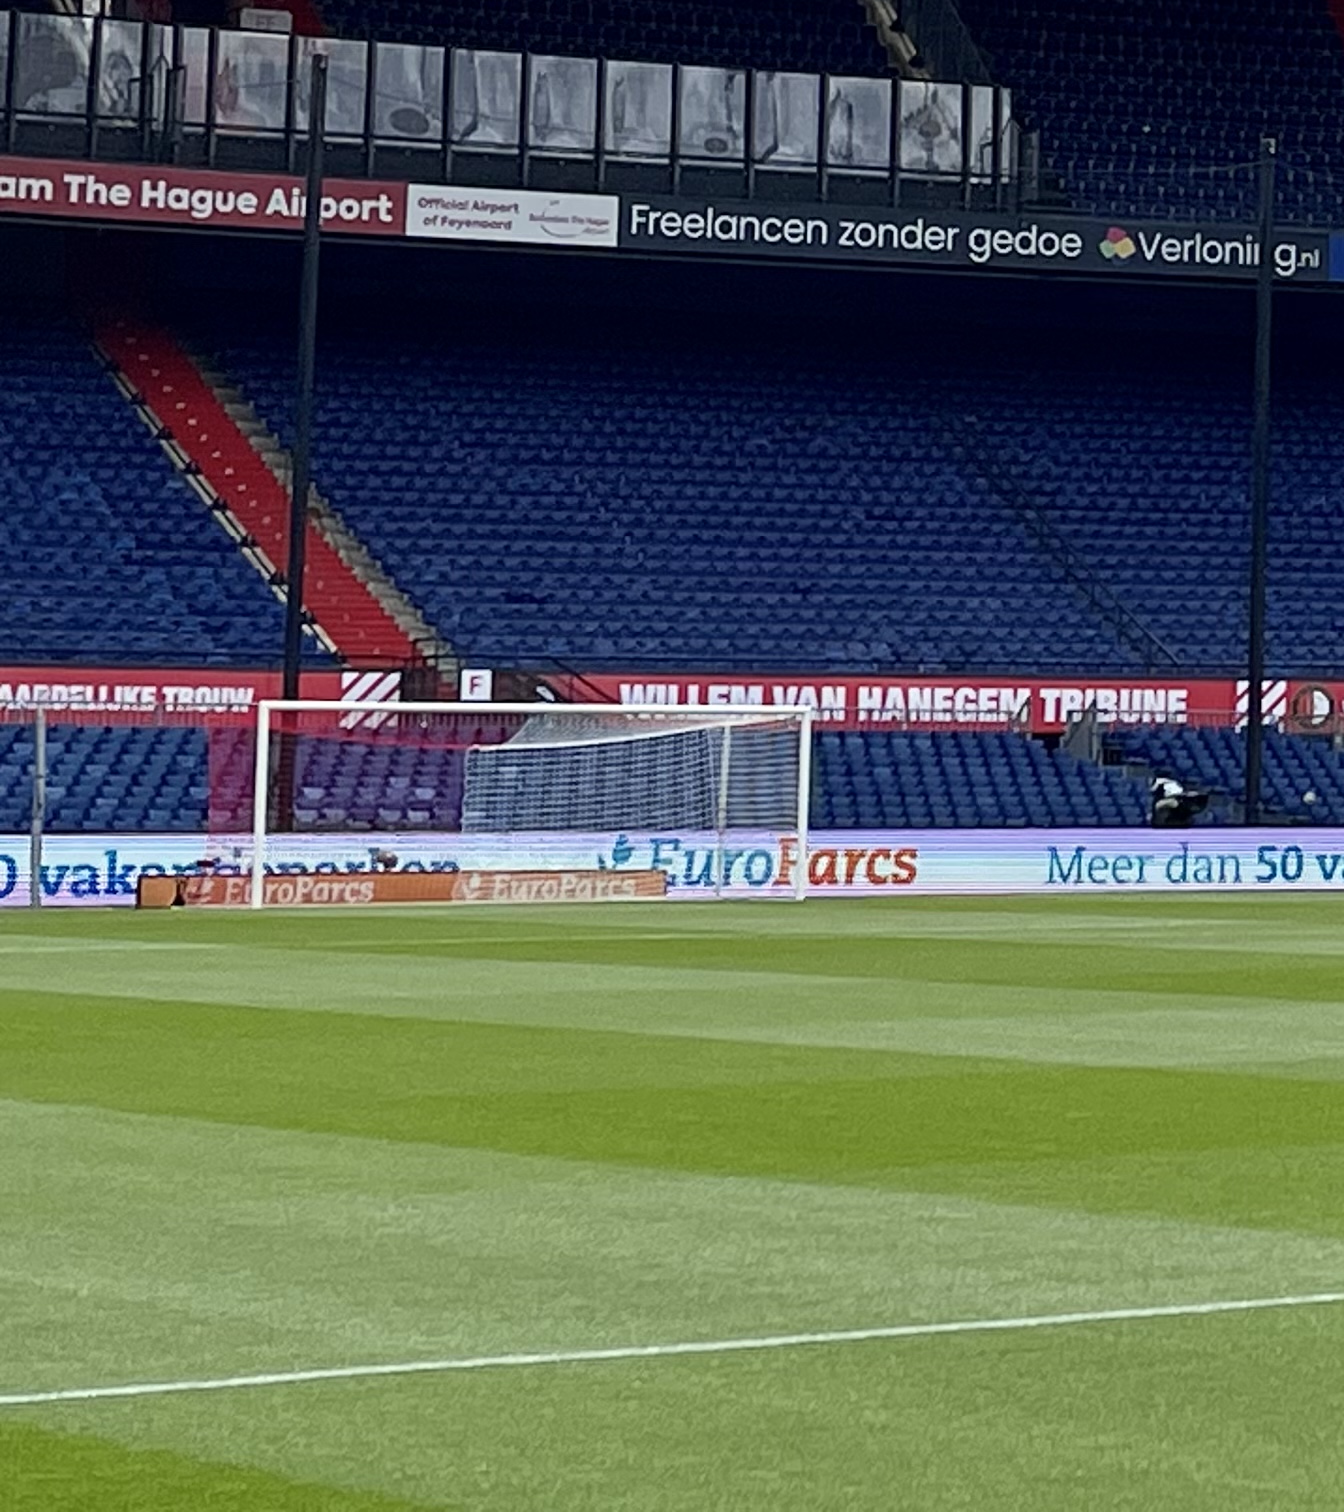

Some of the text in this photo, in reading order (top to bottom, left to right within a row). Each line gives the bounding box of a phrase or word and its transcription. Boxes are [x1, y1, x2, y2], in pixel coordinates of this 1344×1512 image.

[63, 173, 132, 206] The
[140, 179, 258, 219] Hague
[418, 197, 520, 215] Official Airport
[423, 214, 439, 226] of
[440, 215, 513, 231] Feyenoord
[630, 204, 1083, 264] Freelancen zonder gedoe
[469, 675, 481, 694] F
[772, 685, 846, 721] VAN
[857, 685, 1031, 723] HANEGEM
[1045, 845, 1150, 884] Meer
[1166, 841, 1241, 884] dan
[1255, 844, 1302, 885] 50
